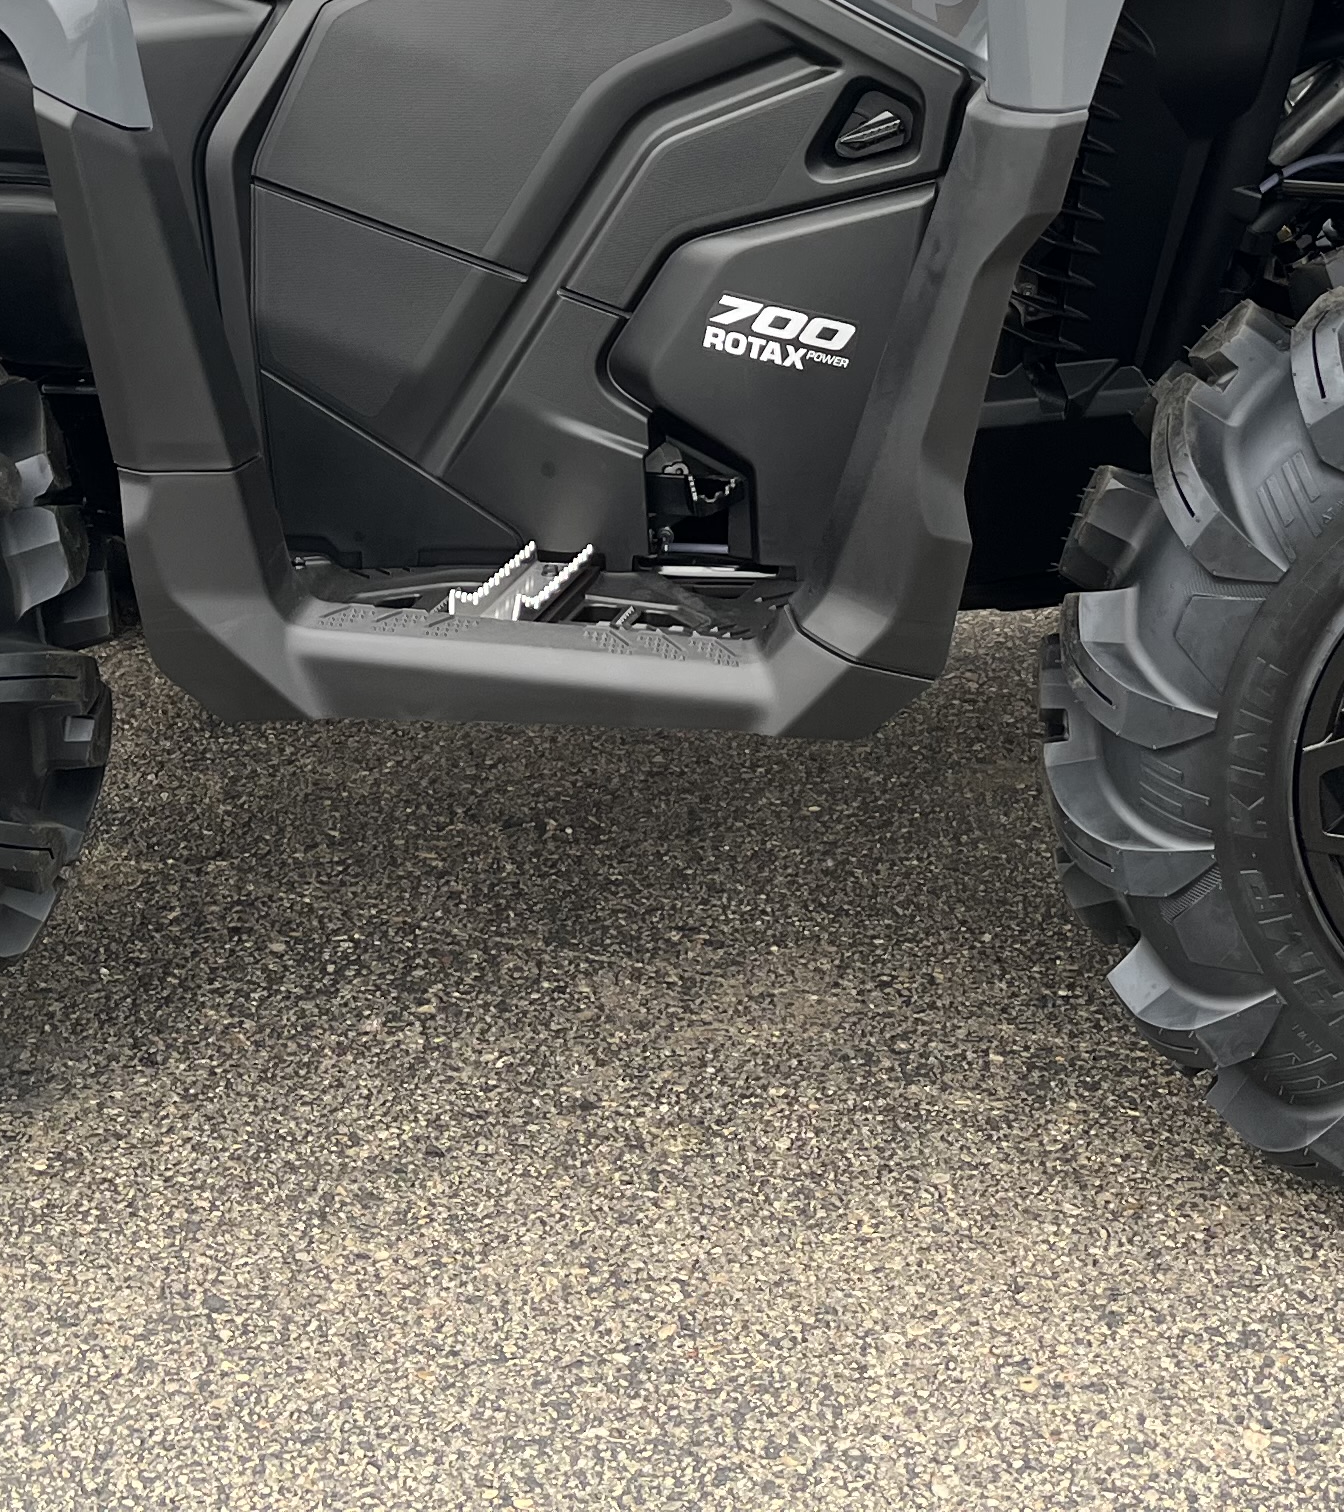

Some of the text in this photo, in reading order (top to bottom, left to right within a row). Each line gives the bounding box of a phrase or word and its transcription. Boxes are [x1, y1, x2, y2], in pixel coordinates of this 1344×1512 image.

[702, 325, 850, 370] ROTAX POWER
[709, 294, 856, 351] 700
